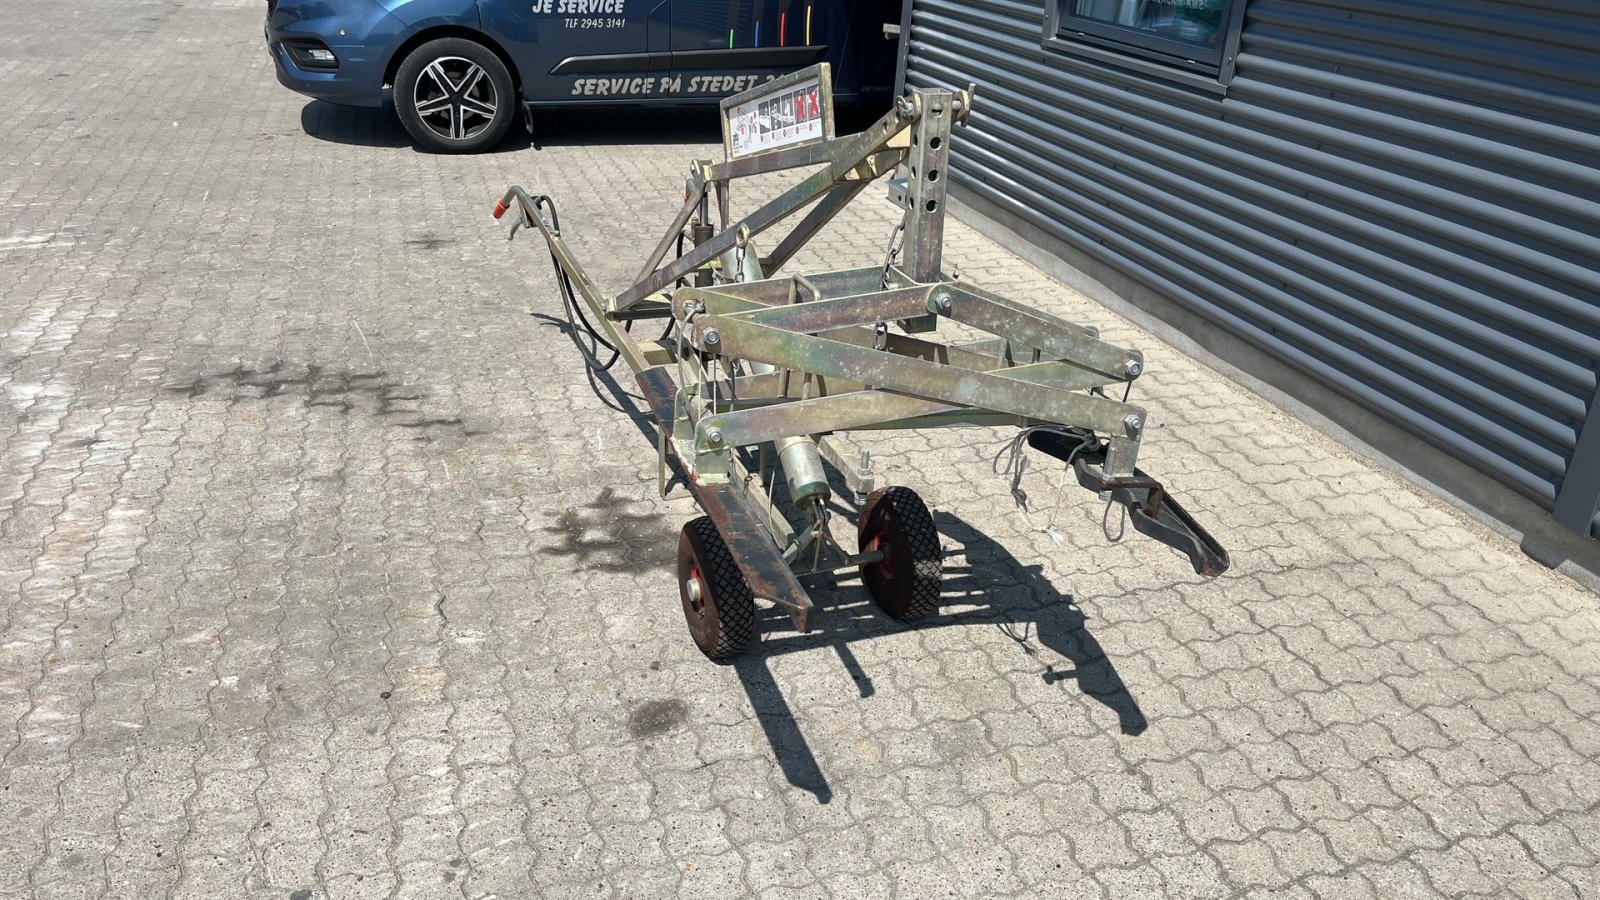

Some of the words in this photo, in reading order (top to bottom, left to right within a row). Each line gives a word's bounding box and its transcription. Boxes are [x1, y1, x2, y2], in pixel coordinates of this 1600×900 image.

[532, 0, 553, 13] JE
[557, 0, 625, 14] SERVICE
[565, 18, 579, 28] TLF
[581, 18, 604, 29] 2945
[606, 18, 626, 28] 3141
[571, 77, 655, 96] SERVICE
[659, 73, 682, 93] PÅ
[687, 75, 759, 92] STEDET
